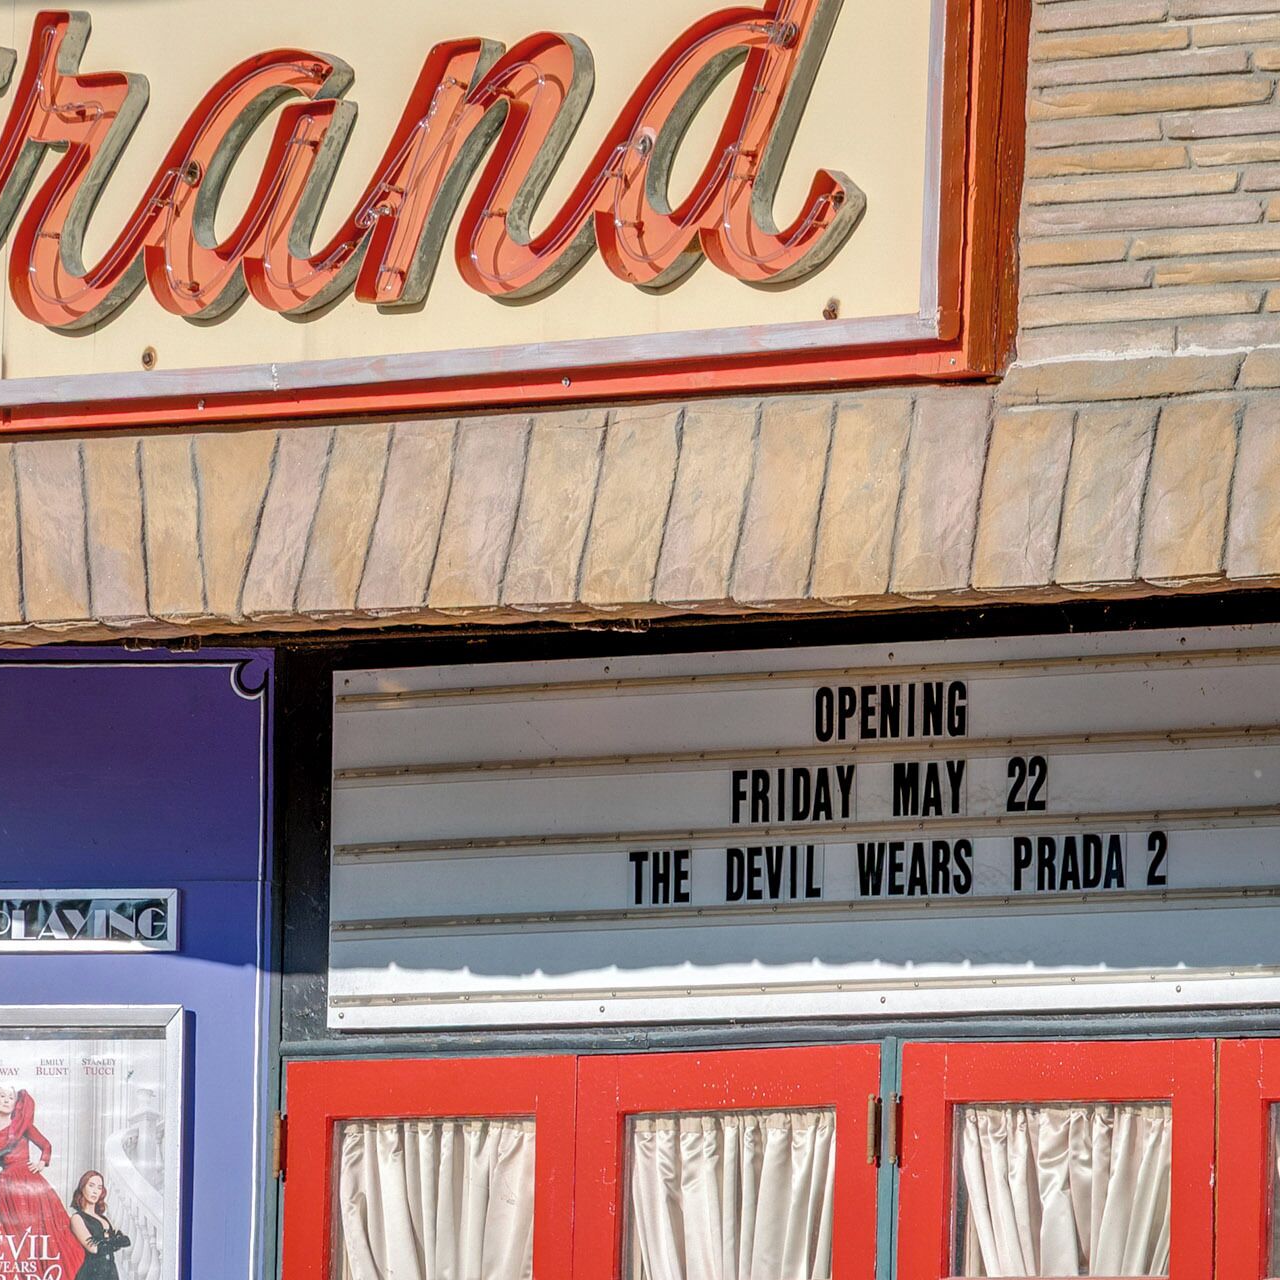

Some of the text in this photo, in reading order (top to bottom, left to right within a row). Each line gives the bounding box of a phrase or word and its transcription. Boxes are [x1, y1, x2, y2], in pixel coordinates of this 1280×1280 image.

[815, 680, 967, 742] OPENING
[731, 755, 1047, 824] FRIDAY MAY 22
[629, 830, 1167, 905] THE DEVIL WEARS PRADA 2
[40, 1058, 65, 1066] EMILY
[81, 1057, 116, 1066] STANLEY
[36, 1066, 69, 1076] BLUNT
[84, 1066, 114, 1076] TUCCI
